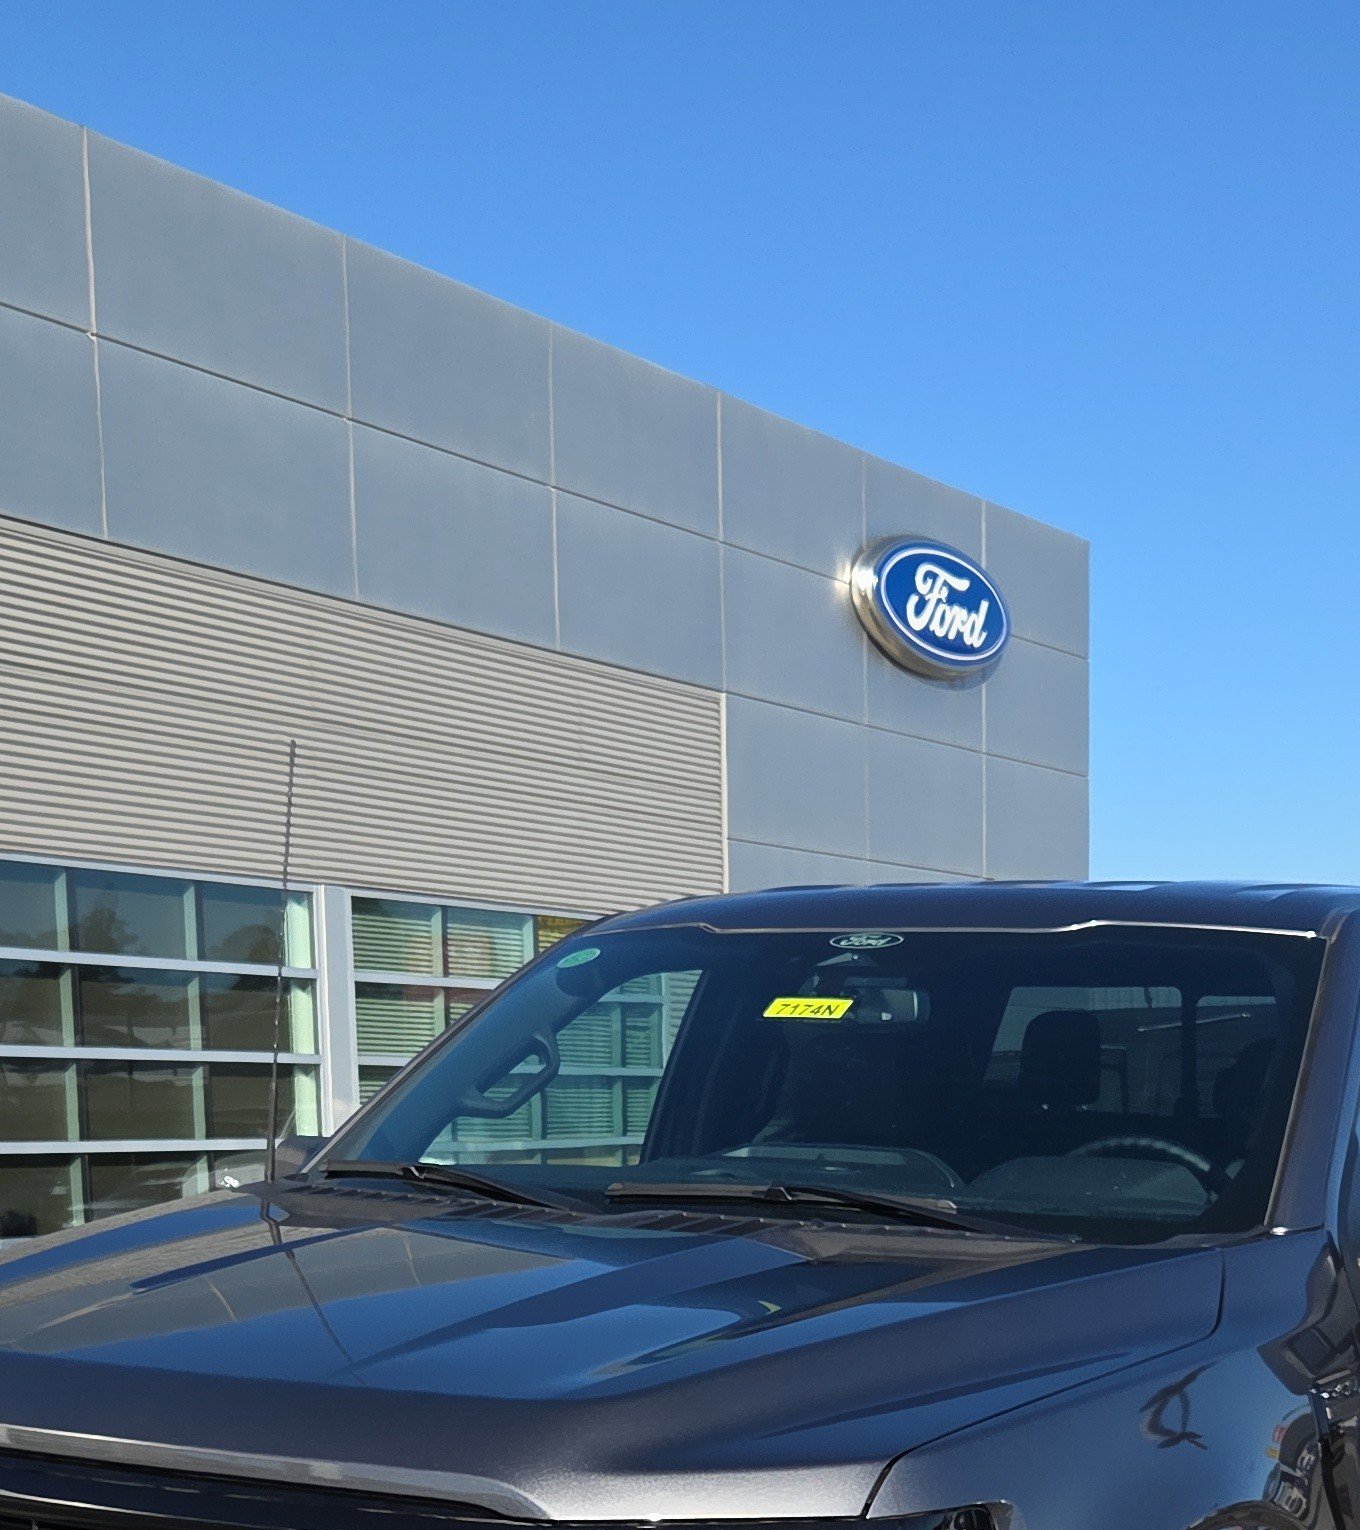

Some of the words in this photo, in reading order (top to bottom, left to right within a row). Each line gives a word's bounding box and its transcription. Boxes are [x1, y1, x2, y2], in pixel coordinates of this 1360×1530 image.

[906, 562, 990, 648] Ford
[840, 933, 892, 946] Ford
[777, 1003, 840, 1017] 7174N
